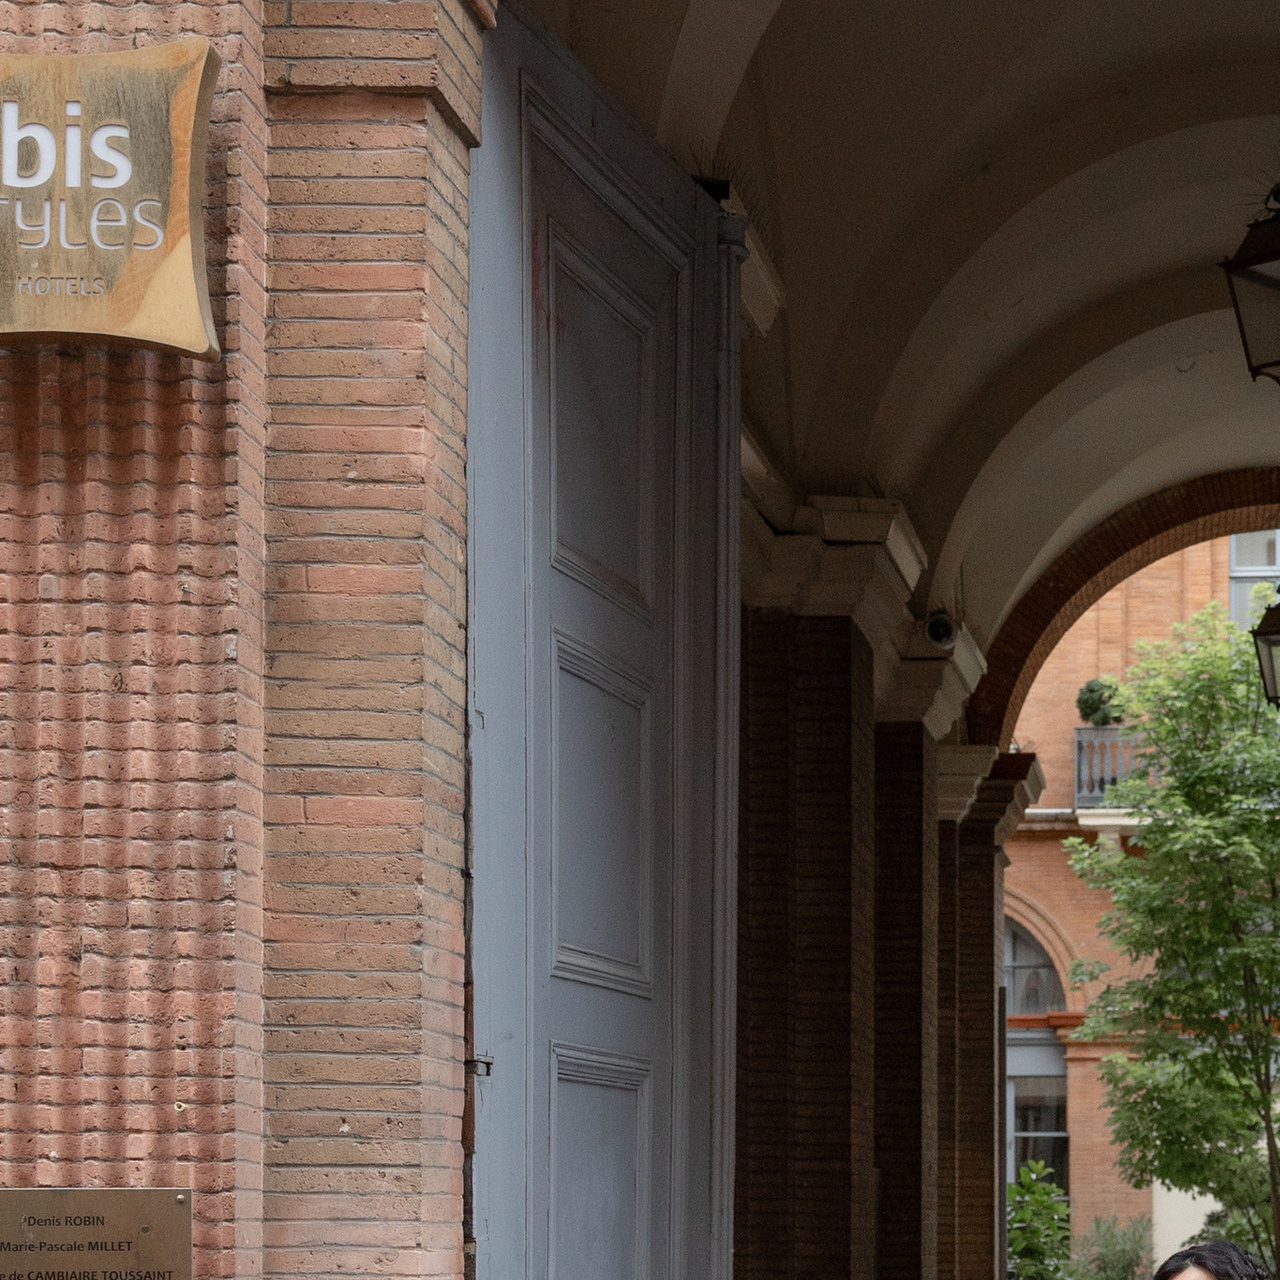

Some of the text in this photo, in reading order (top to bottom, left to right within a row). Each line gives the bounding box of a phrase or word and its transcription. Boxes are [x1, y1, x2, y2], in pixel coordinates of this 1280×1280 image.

[1, 100, 132, 189] bis
[17, 276, 105, 296] HOTELS
[27, 1216, 105, 1226] Denis ROBIN
[0, 1241, 133, 1252] Marie-Pascale MILLET
[101, 1270, 174, 1280] TOUSSAINT
